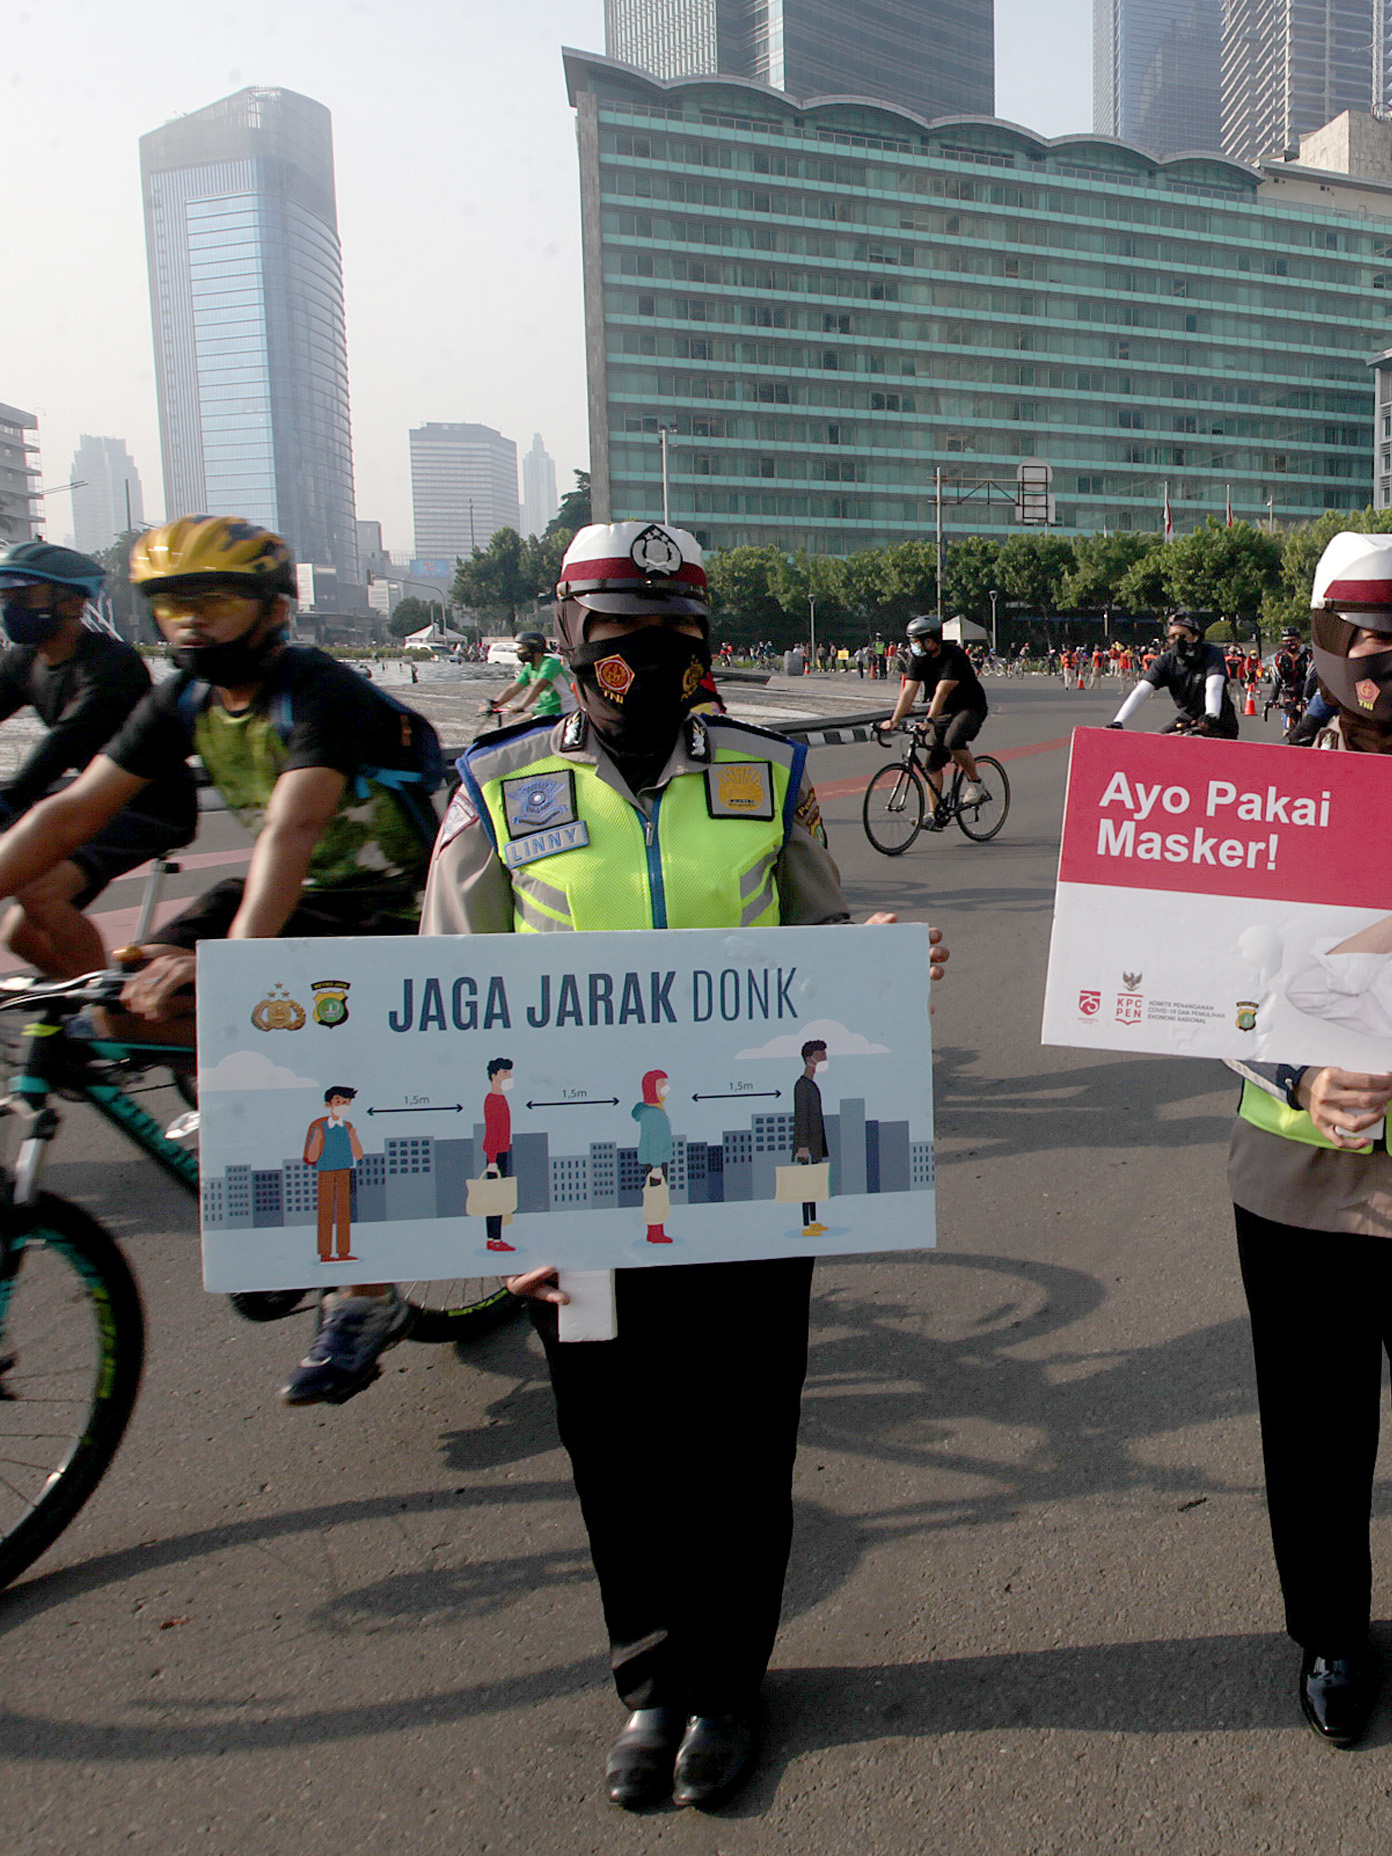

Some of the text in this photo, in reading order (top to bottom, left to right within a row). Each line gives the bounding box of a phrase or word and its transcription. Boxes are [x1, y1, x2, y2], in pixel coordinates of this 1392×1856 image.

[602, 689, 624, 704] TNI
[1358, 699, 1374, 711] TNI
[1099, 771, 1331, 827] Ayo Pakai
[511, 827, 577, 862] LINNY
[1097, 818, 1279, 870] Masker!
[388, 967, 799, 1033] JAGA JARAK DONK
[1116, 998, 1142, 1008] KPC
[1115, 1007, 1142, 1018] PEN
[1177, 1016, 1206, 1024] NASIONAL
[729, 1081, 755, 1091] 1,5m
[562, 1088, 588, 1098] 1,5m
[403, 1095, 430, 1105] 1,5m
